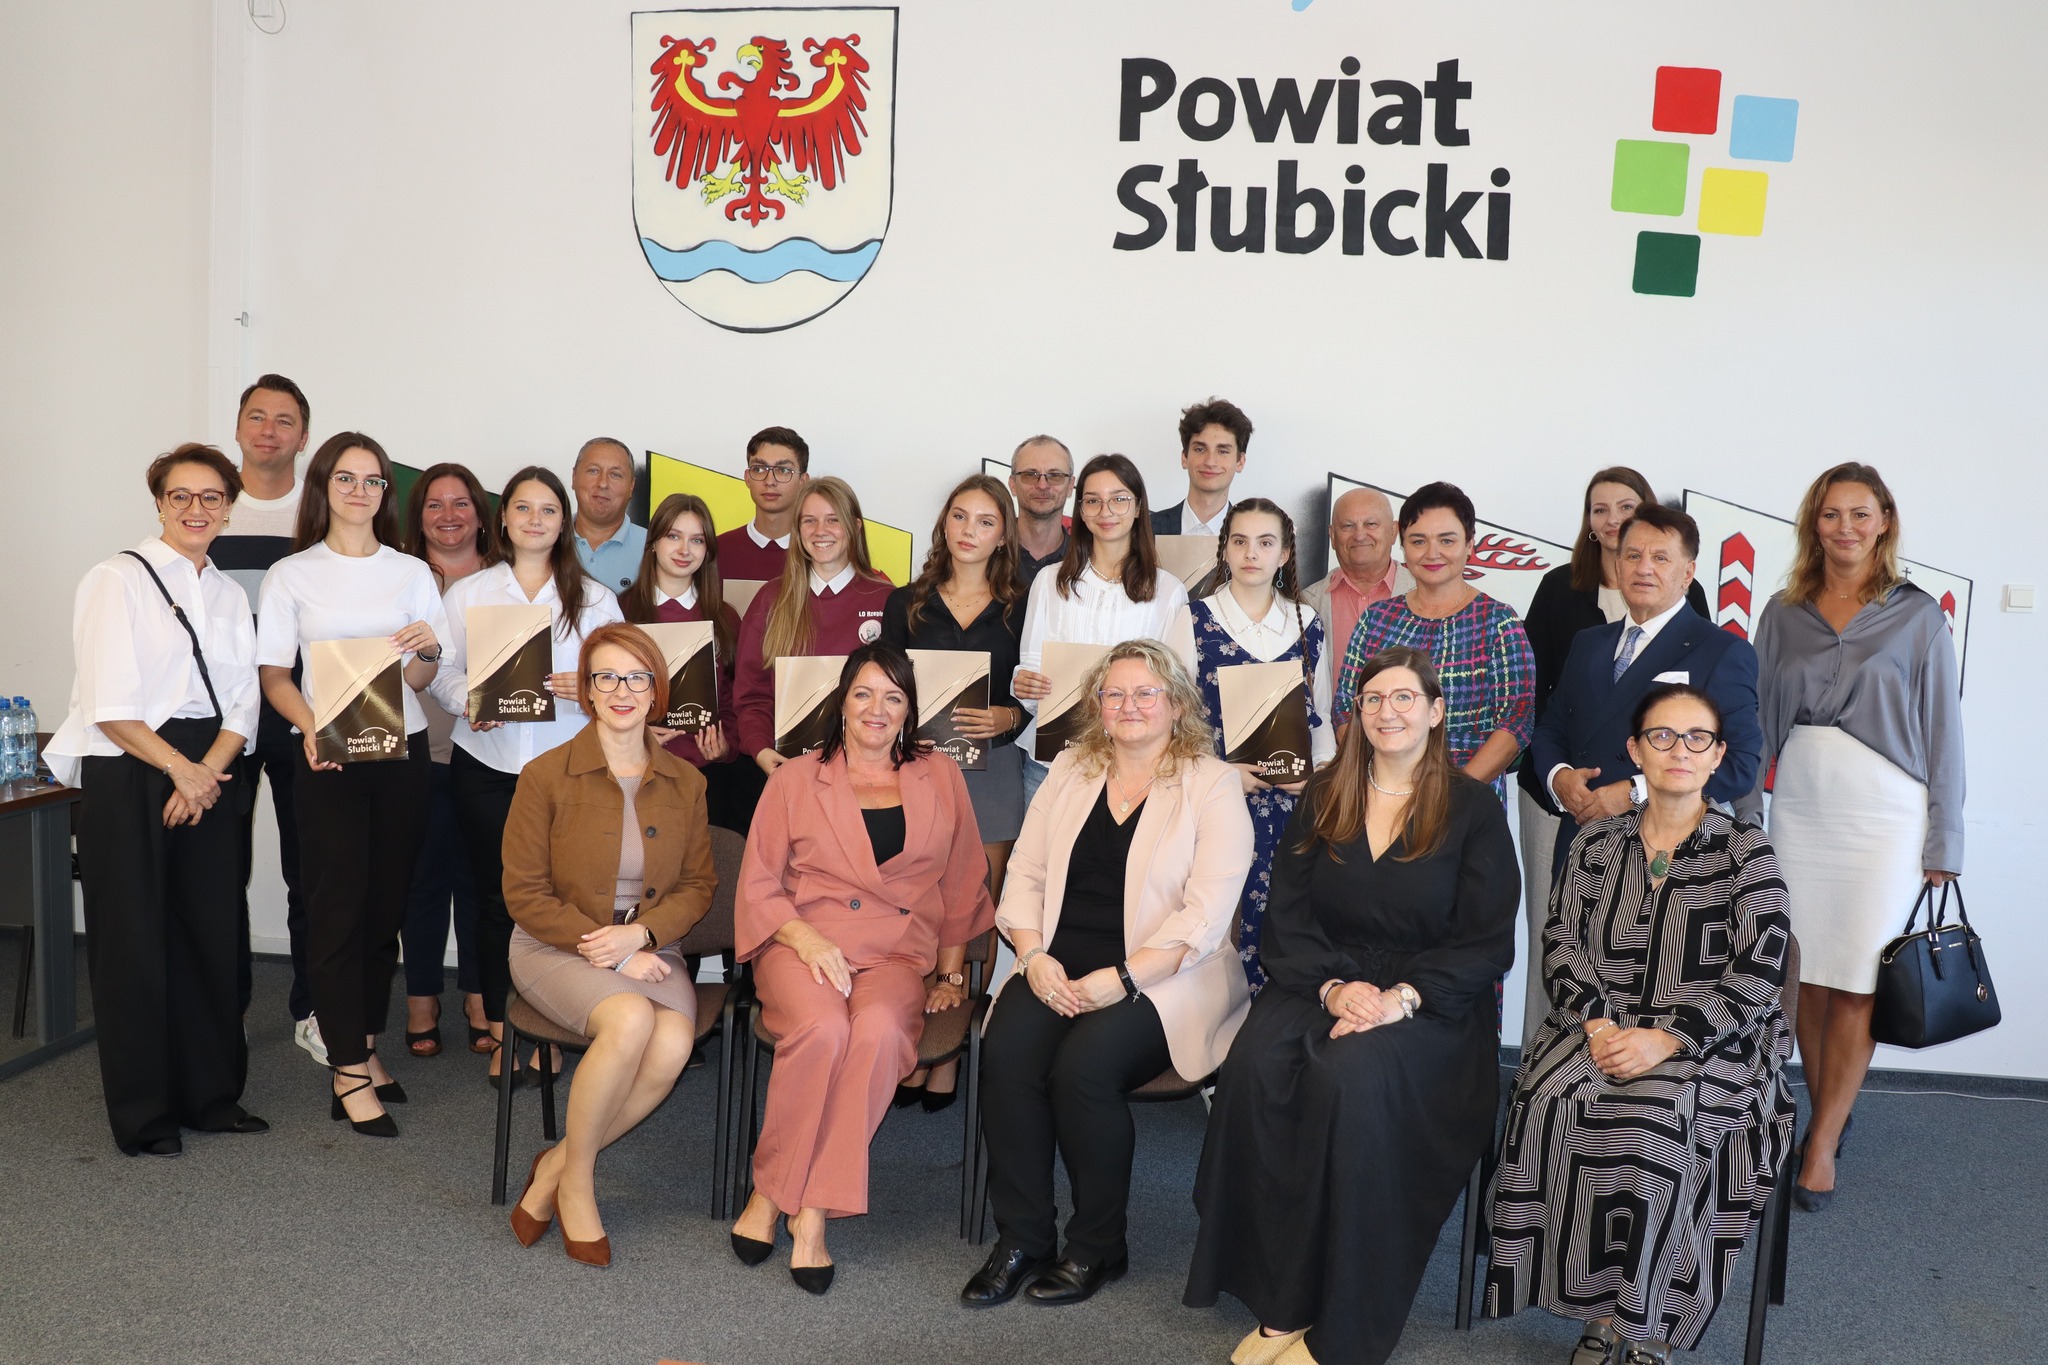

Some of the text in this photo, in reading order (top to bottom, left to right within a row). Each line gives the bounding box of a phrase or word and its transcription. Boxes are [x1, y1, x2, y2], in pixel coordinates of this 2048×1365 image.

[1119, 56, 1472, 146] Powiat
[1112, 158, 1511, 260] Słubicki
[498, 697, 527, 706] Powiat
[498, 705, 531, 714] Słubicki
[666, 710, 693, 719] Powiat
[667, 717, 697, 727] Słubicki
[347, 735, 376, 745] Powiat
[347, 743, 380, 754] Słubicki
[1257, 758, 1285, 768] Powiat
